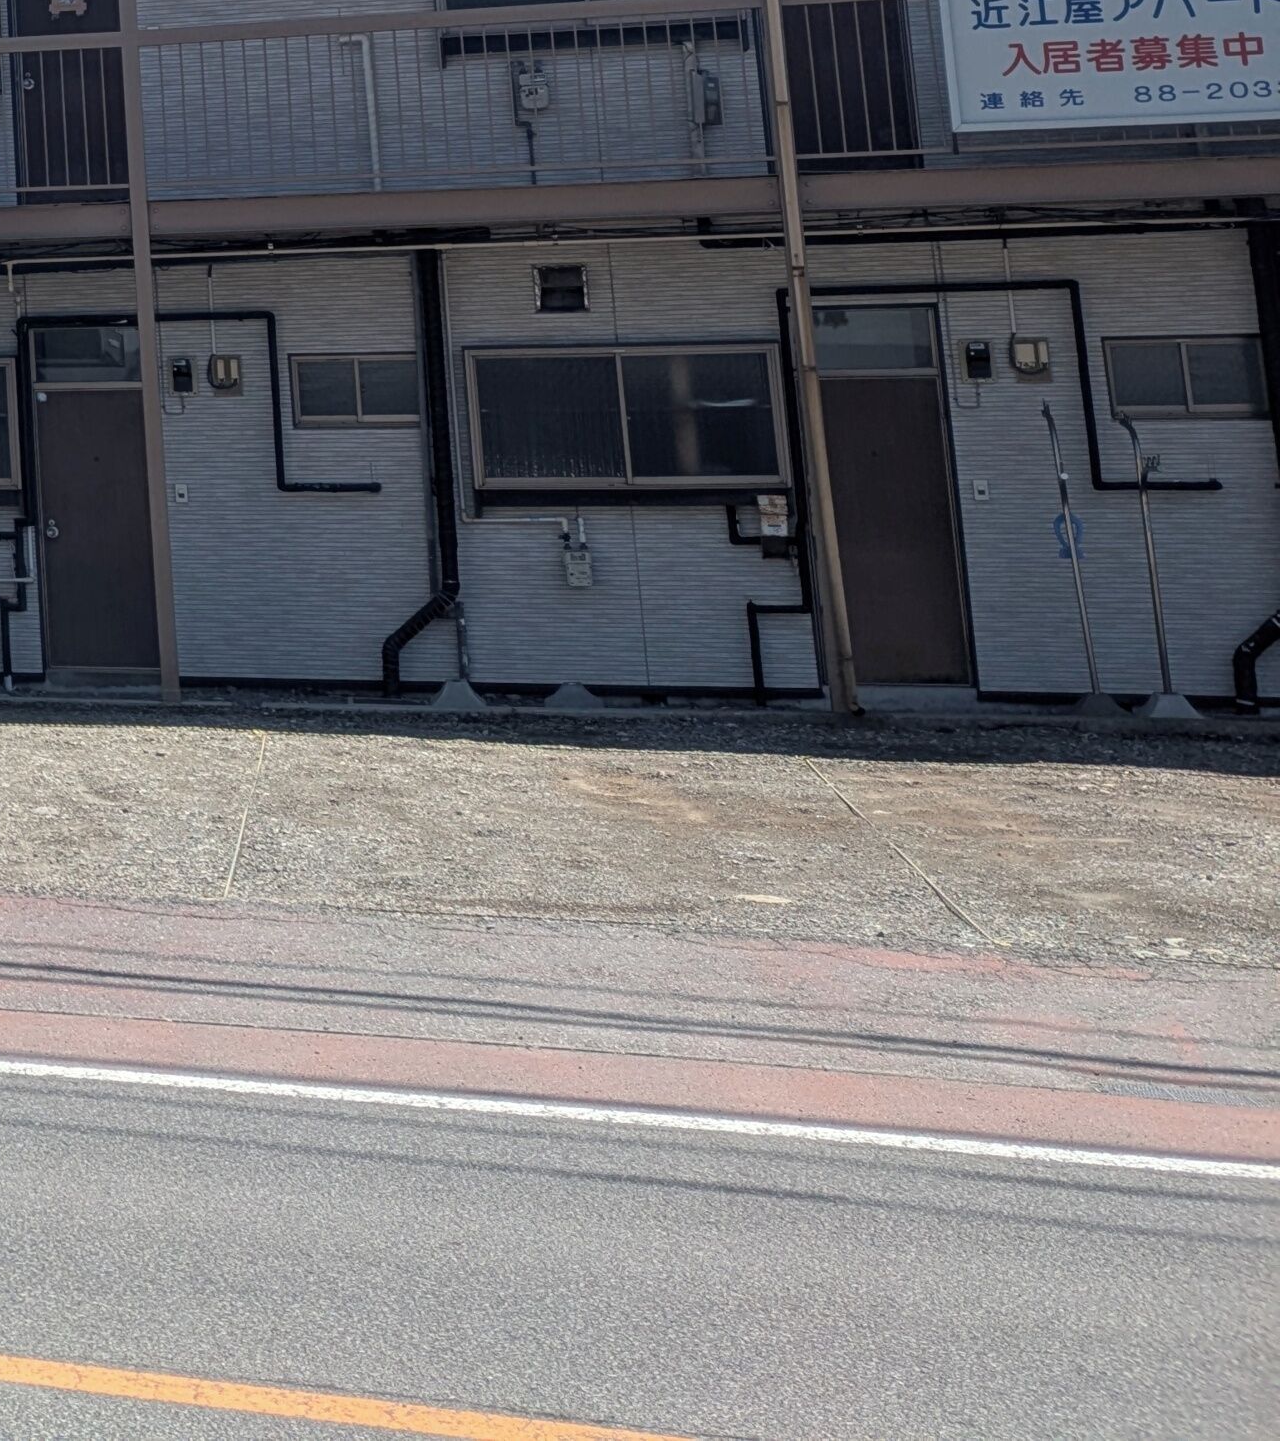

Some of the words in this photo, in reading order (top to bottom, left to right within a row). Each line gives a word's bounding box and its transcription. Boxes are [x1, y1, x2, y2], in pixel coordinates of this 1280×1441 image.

[1001, 31, 1265, 77] 入居者募集中
[980, 88, 1085, 111] 連絡先
[1133, 79, 1280, 104] 88-203
